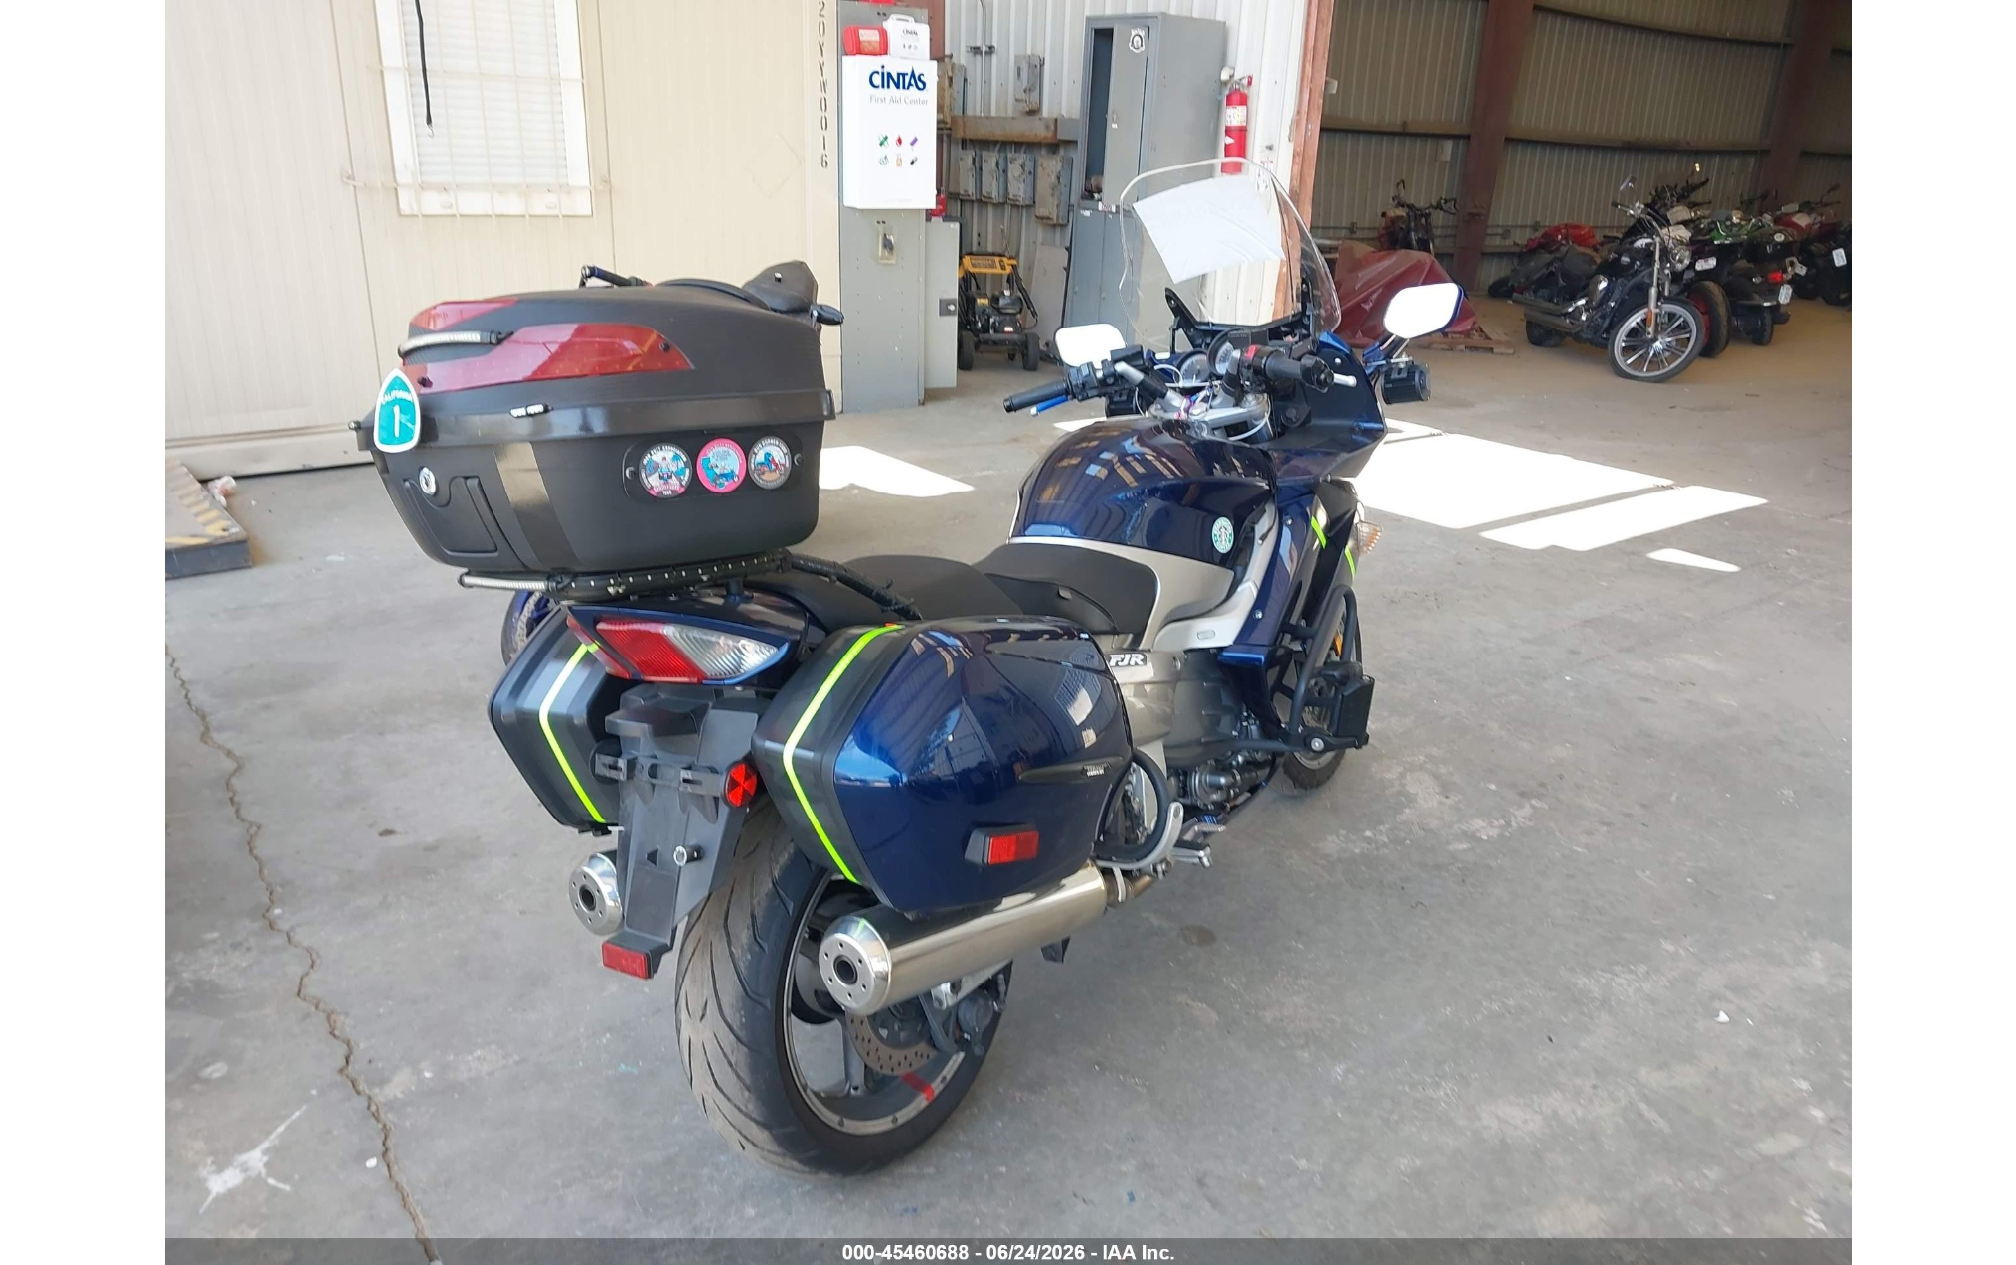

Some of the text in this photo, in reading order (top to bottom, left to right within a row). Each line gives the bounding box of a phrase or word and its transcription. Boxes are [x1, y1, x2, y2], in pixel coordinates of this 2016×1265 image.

[868, 64, 927, 91] CINTAS
[869, 95, 929, 106] First Aid Center
[393, 404, 400, 438] 1
[1109, 653, 1146, 667] FJR
